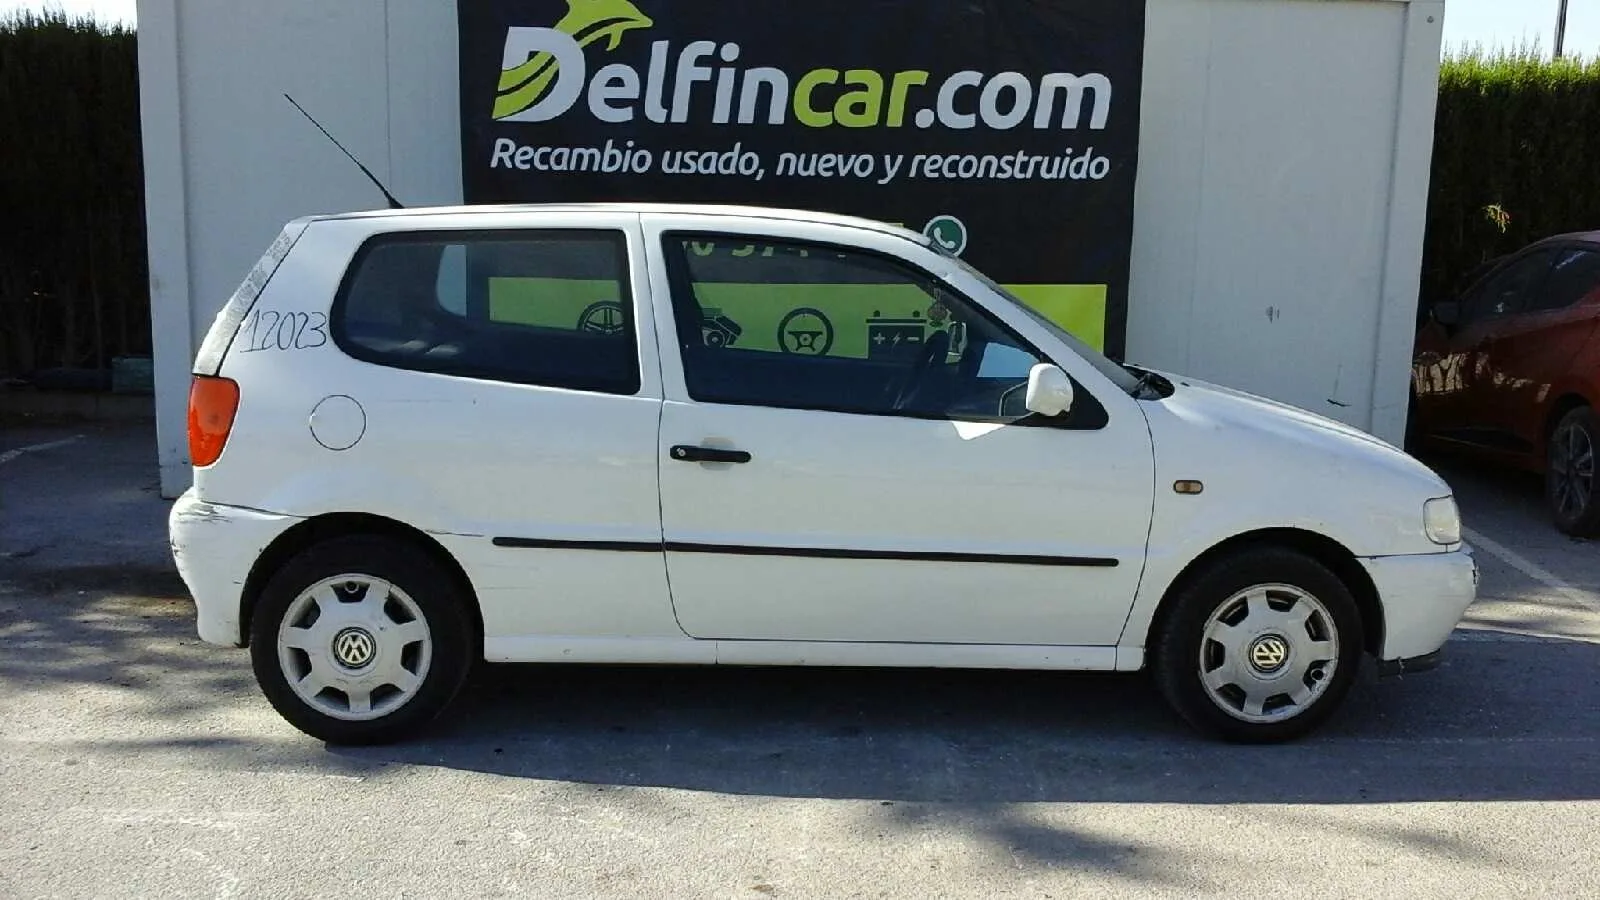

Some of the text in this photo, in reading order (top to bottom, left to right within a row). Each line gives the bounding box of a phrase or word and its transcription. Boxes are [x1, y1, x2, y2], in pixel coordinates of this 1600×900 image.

[492, 27, 1112, 131] Delfincar.com
[490, 137, 1111, 185] Recambio usado, nuevo y reconstruido
